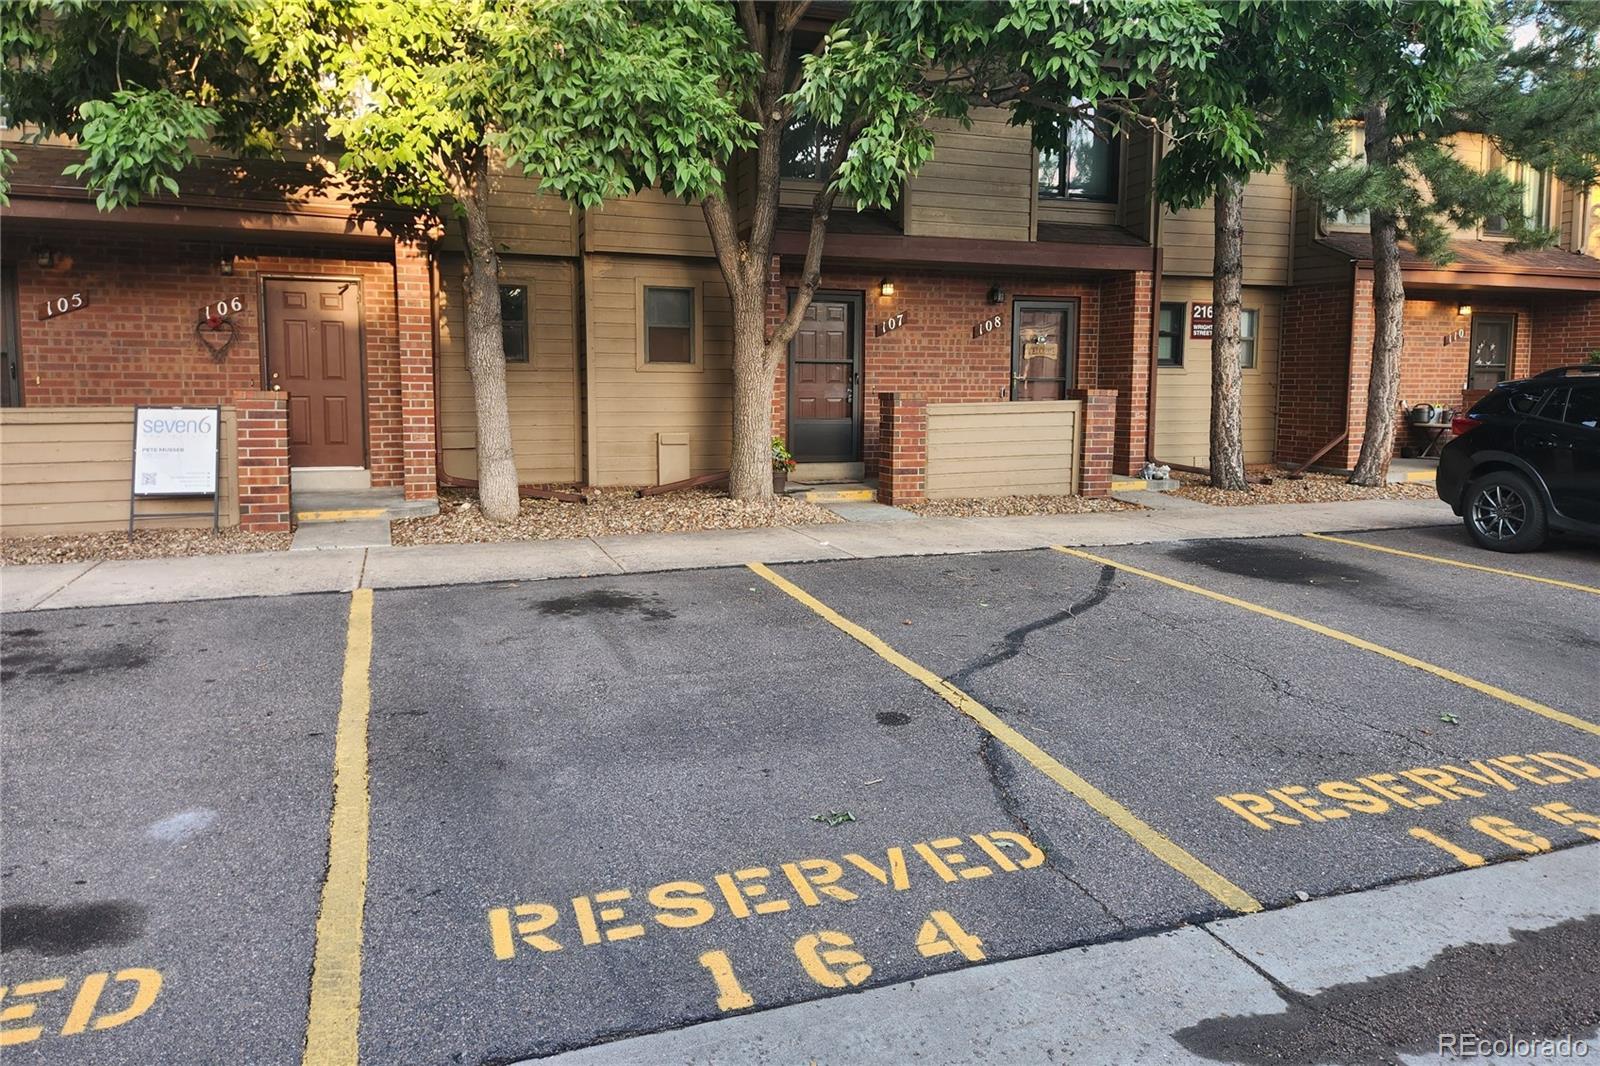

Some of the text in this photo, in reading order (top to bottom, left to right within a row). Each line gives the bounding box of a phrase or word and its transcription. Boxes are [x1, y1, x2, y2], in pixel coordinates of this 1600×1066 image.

[47, 293, 83, 316] 105
[205, 297, 242, 319] 106
[882, 314, 904, 333] 107
[979, 316, 1001, 335] 108
[143, 415, 211, 434] seven6
[1215, 751, 1600, 831] RESERVED
[489, 829, 1047, 961] RESERVED
